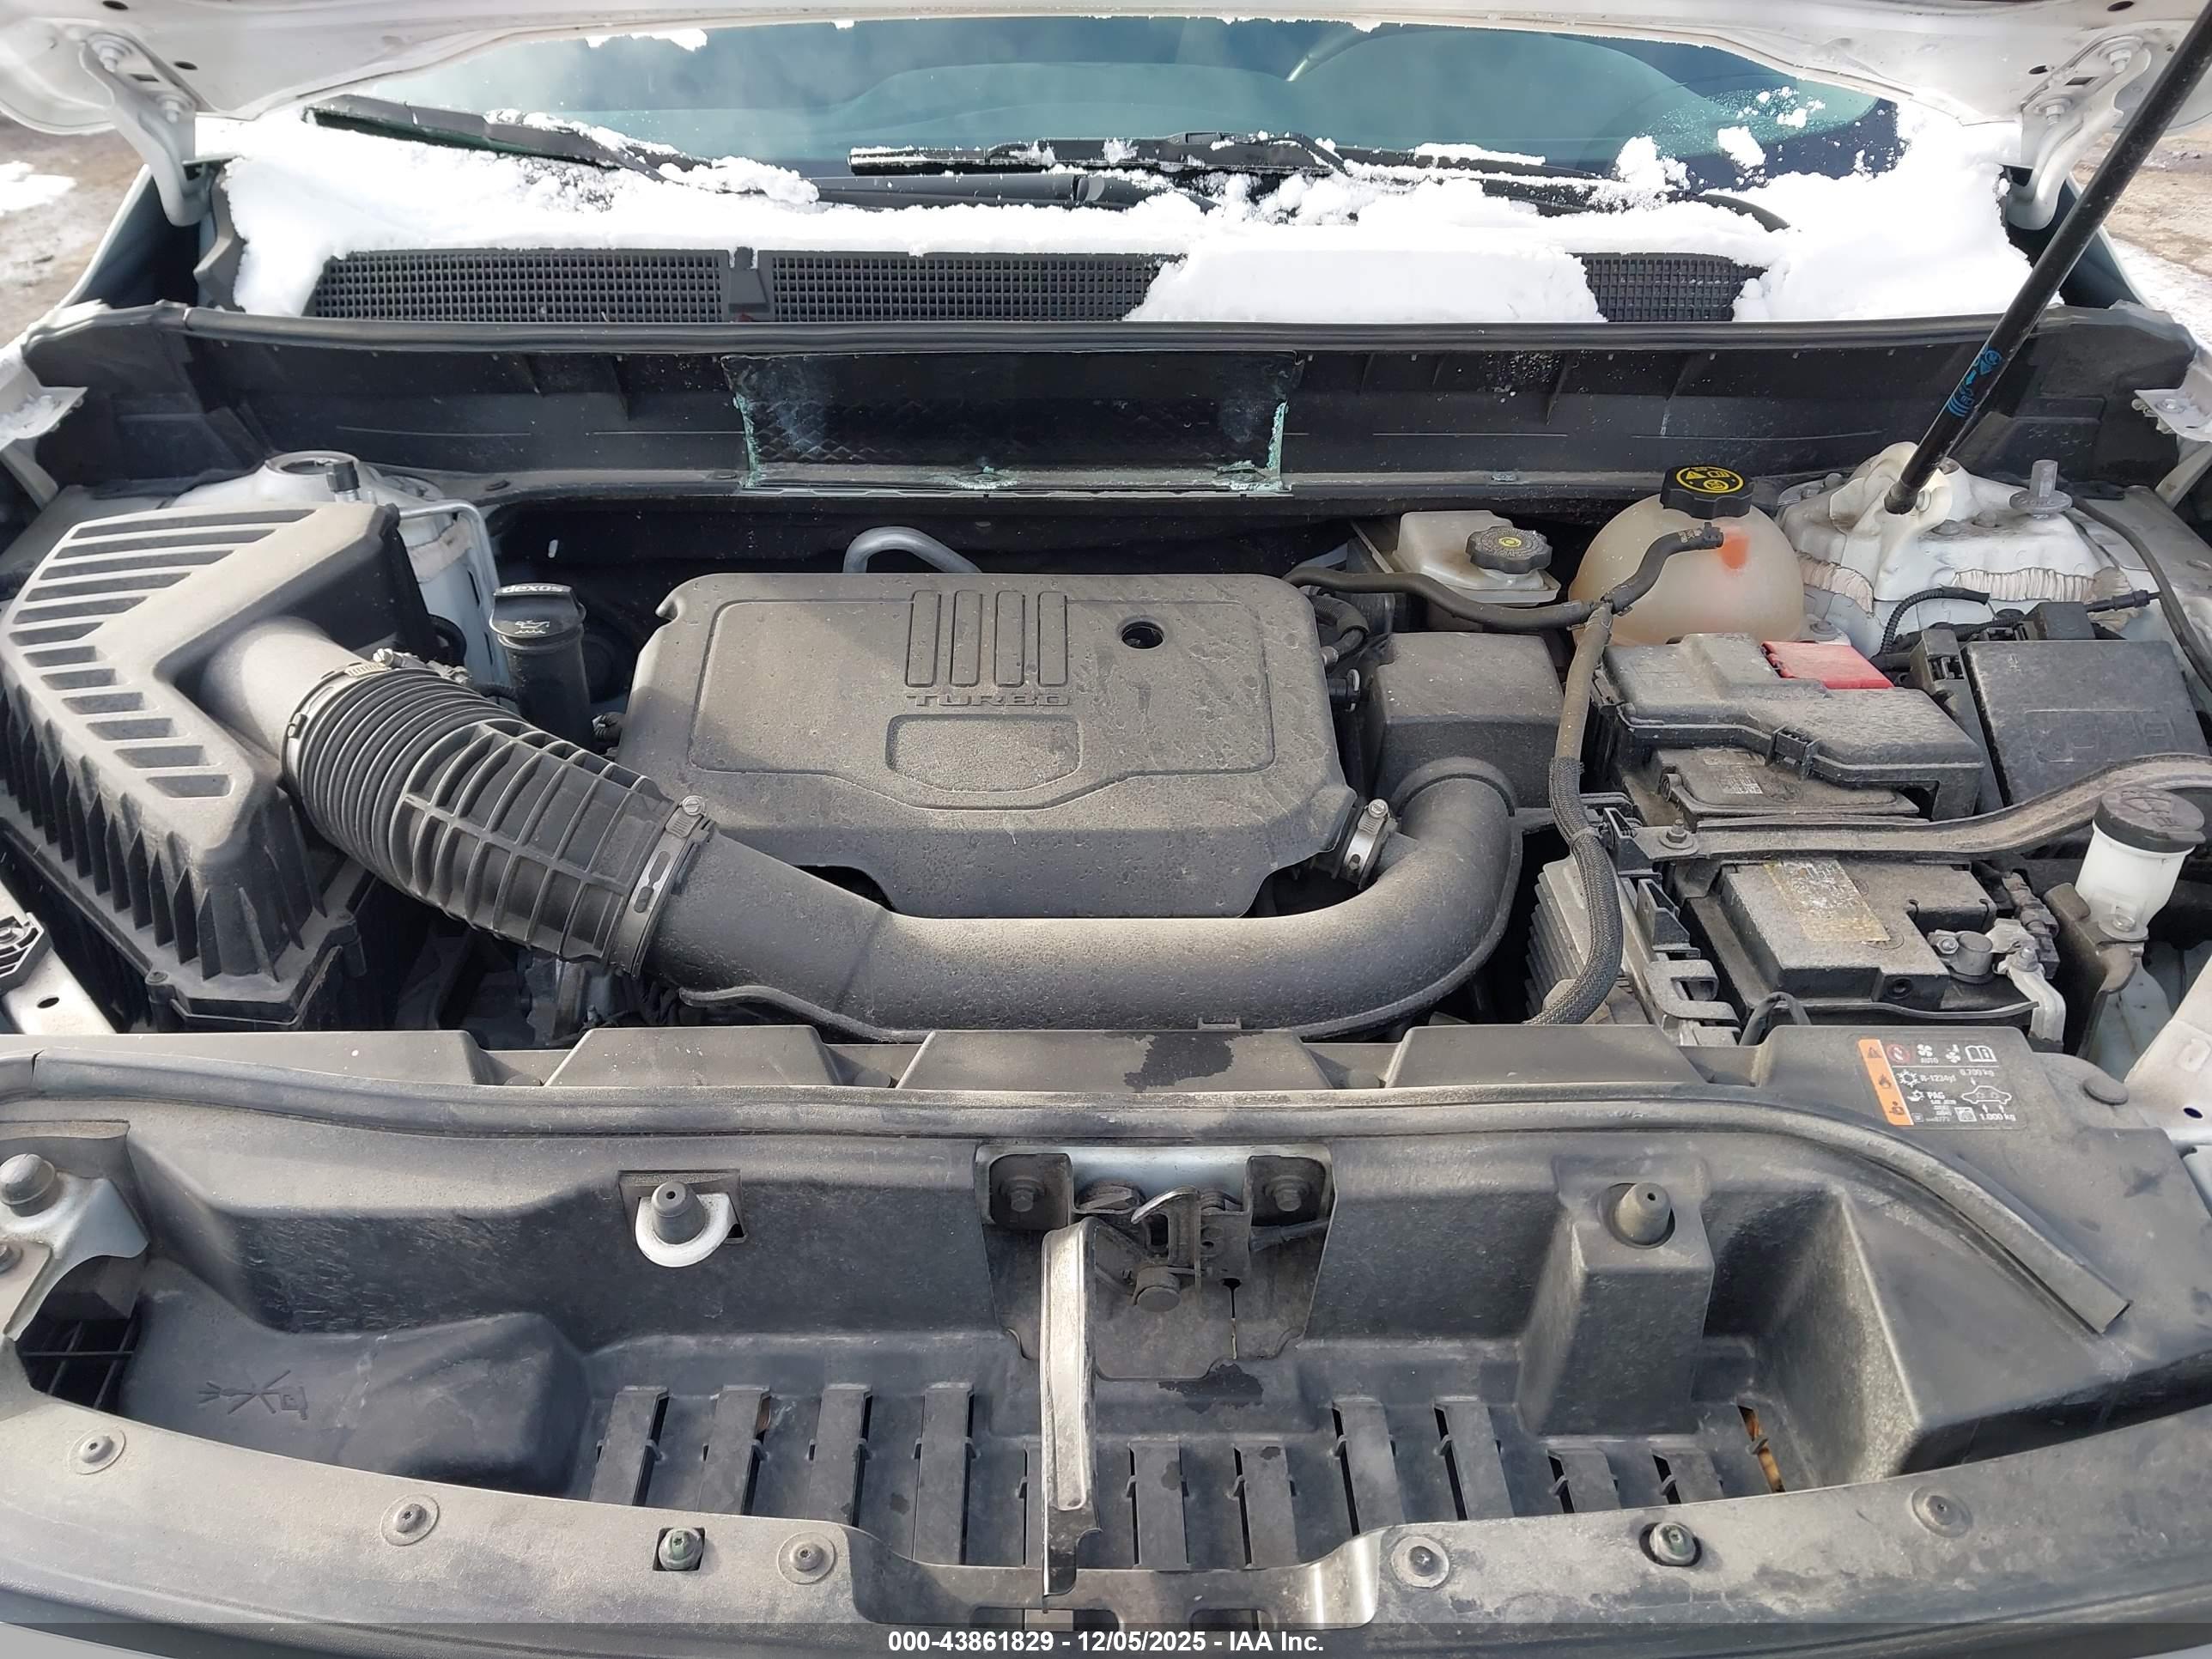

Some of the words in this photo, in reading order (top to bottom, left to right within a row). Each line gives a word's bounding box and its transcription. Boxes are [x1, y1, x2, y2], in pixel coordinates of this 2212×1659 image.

[501, 585, 563, 593] dexos
[906, 695, 1070, 707] TURBO
[2003, 1113, 2016, 1121] kg
